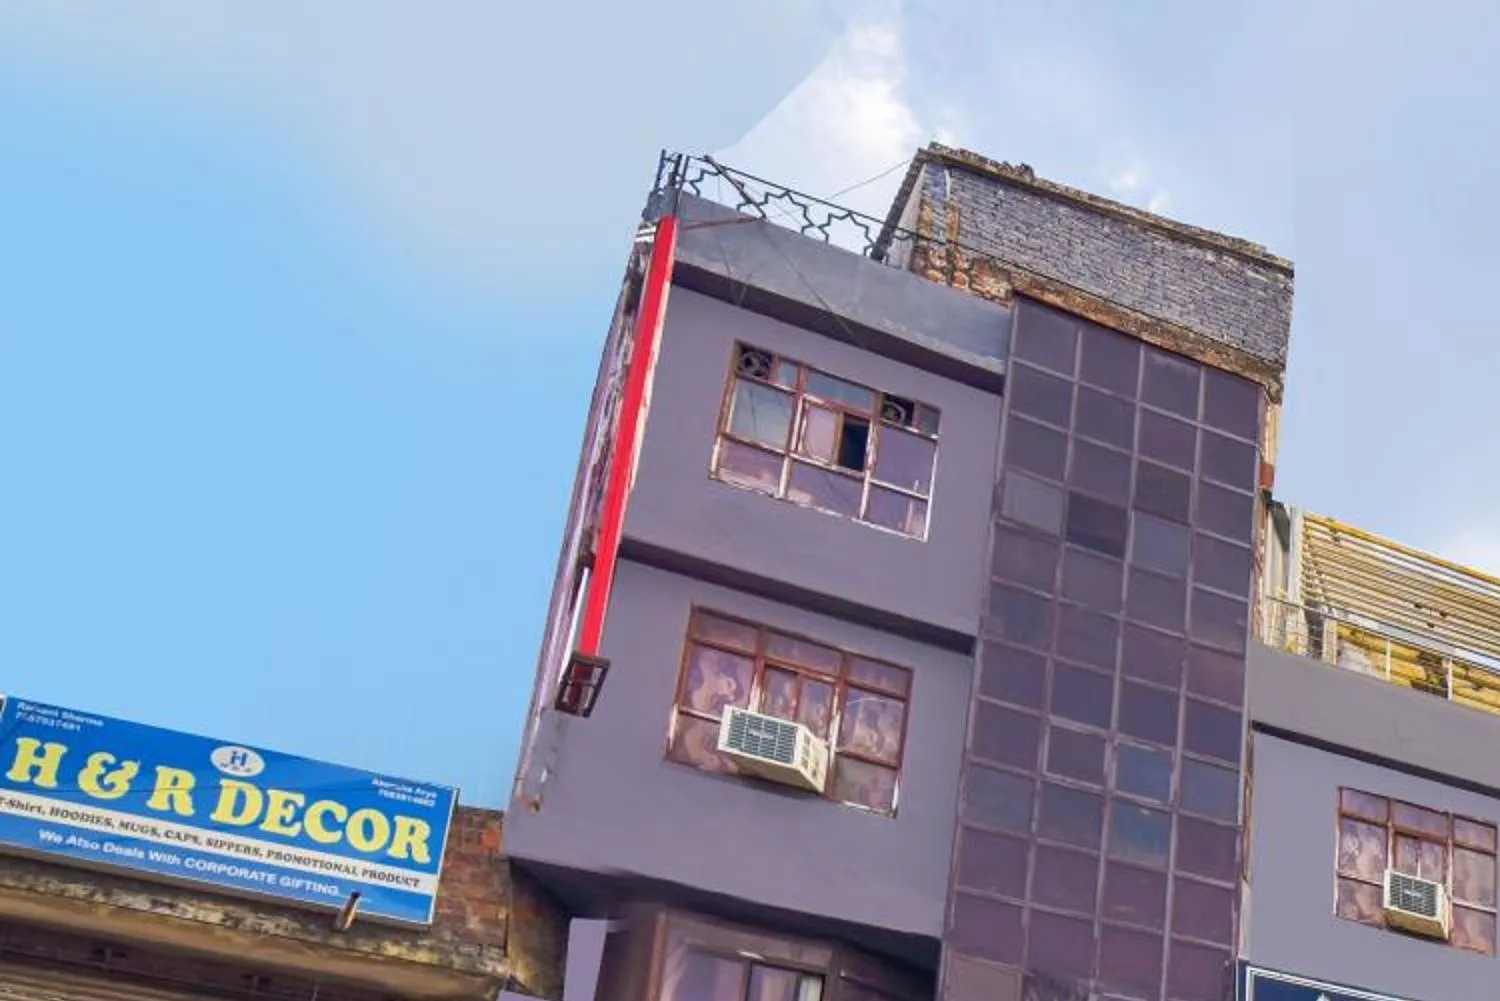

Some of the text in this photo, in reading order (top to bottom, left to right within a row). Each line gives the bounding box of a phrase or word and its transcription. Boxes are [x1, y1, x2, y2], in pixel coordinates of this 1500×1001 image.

[7, 737, 432, 865] H & R DECOR
[39, 829, 63, 844] We
[66, 835, 100, 850] Also
[103, 841, 145, 859] Deals
[149, 850, 181, 866] With
[184, 857, 280, 886] CORPORATE
[266, 849, 359, 877] PROMOTIONAL
[361, 868, 421, 889] PRODUCT
